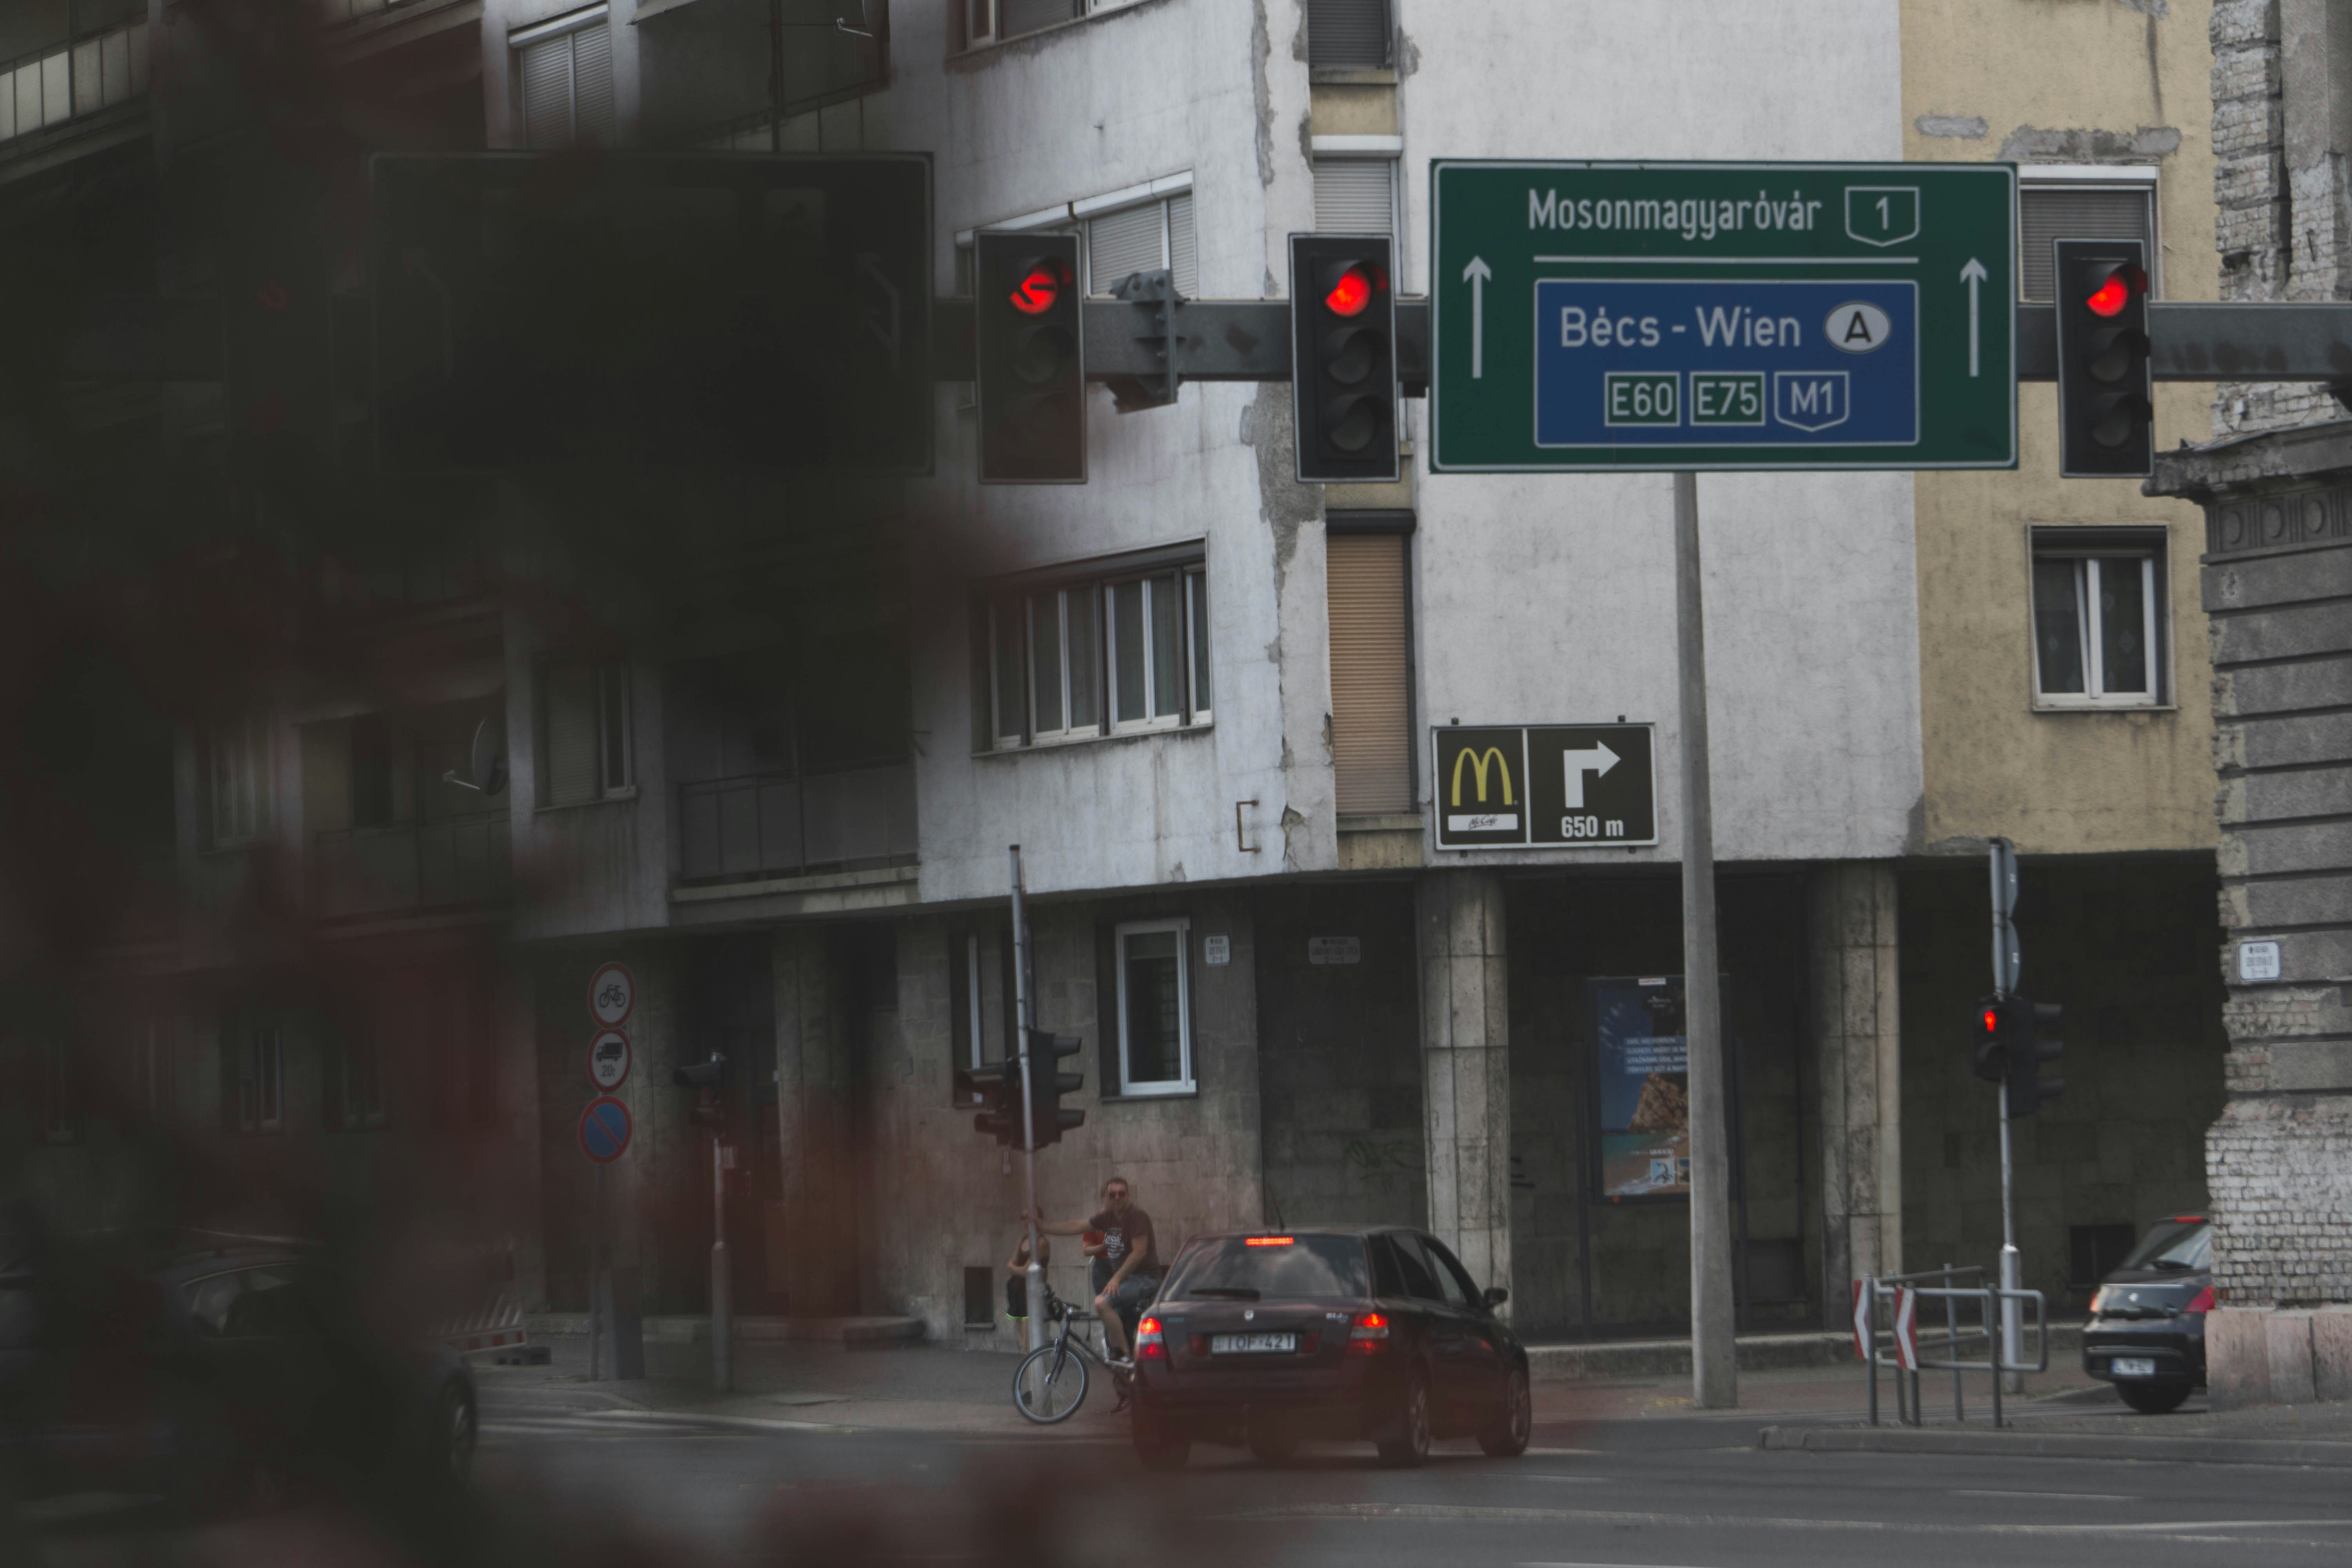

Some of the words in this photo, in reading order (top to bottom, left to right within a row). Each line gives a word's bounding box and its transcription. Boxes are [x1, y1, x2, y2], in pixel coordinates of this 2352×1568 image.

[1529, 189, 1822, 240] Mosonmagyaróvár
[1876, 196, 1888, 230] 1
[1561, 307, 1660, 347] Bécs
[1695, 306, 1800, 347] Wien
[1844, 310, 1872, 343] A
[1612, 382, 1673, 416] E60
[1697, 381, 1758, 416] E75
[1791, 381, 1832, 414] M1
[1561, 815, 1598, 838] 650
[1605, 820, 1623, 837] m
